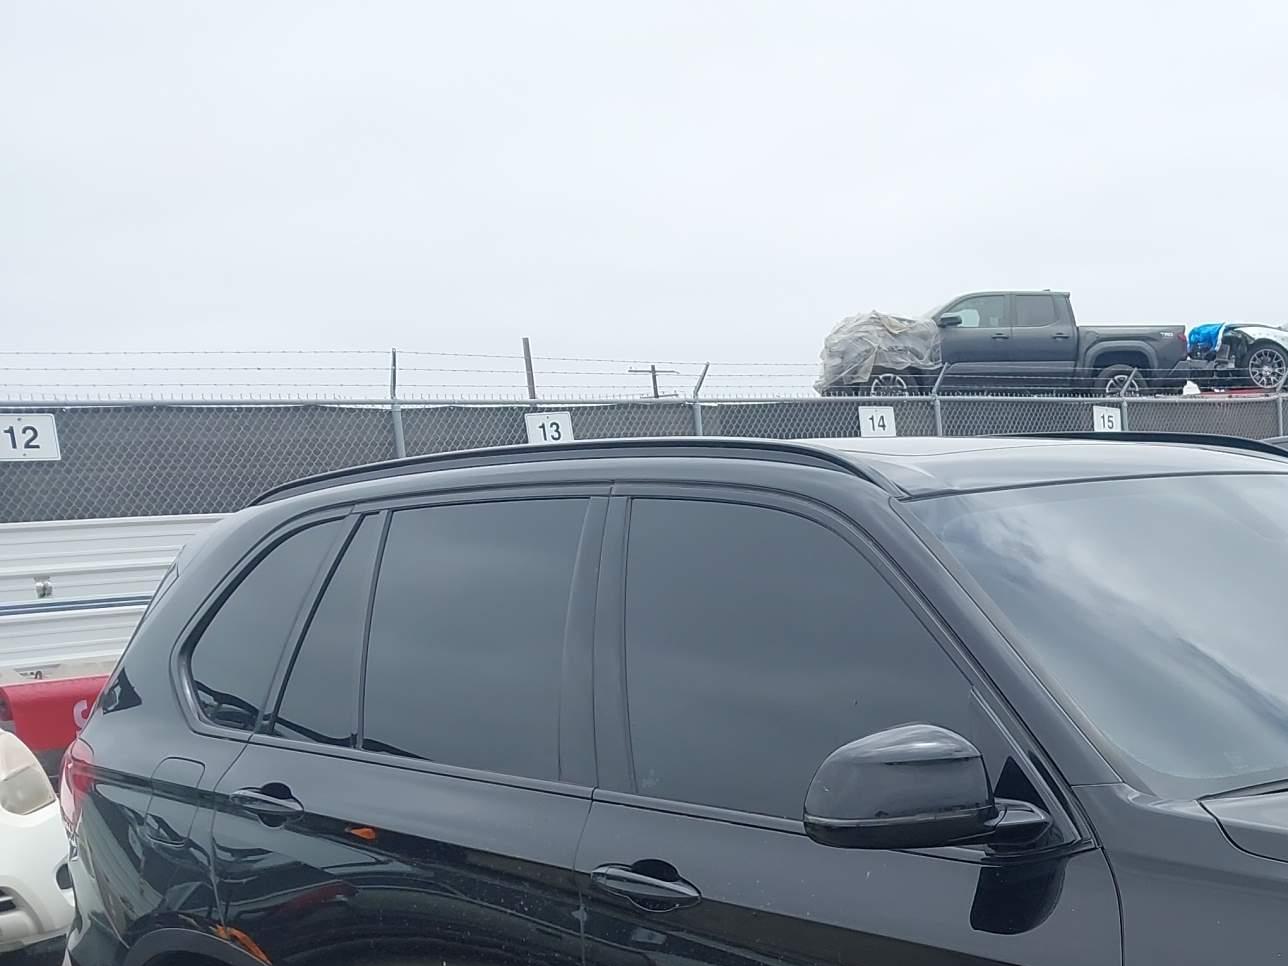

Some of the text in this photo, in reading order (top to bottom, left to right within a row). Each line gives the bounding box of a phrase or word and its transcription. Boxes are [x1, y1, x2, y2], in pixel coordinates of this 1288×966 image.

[538, 421, 562, 441] 13
[868, 414, 887, 432] 14
[1100, 413, 1114, 430] 15
[3, 425, 41, 450] 12
